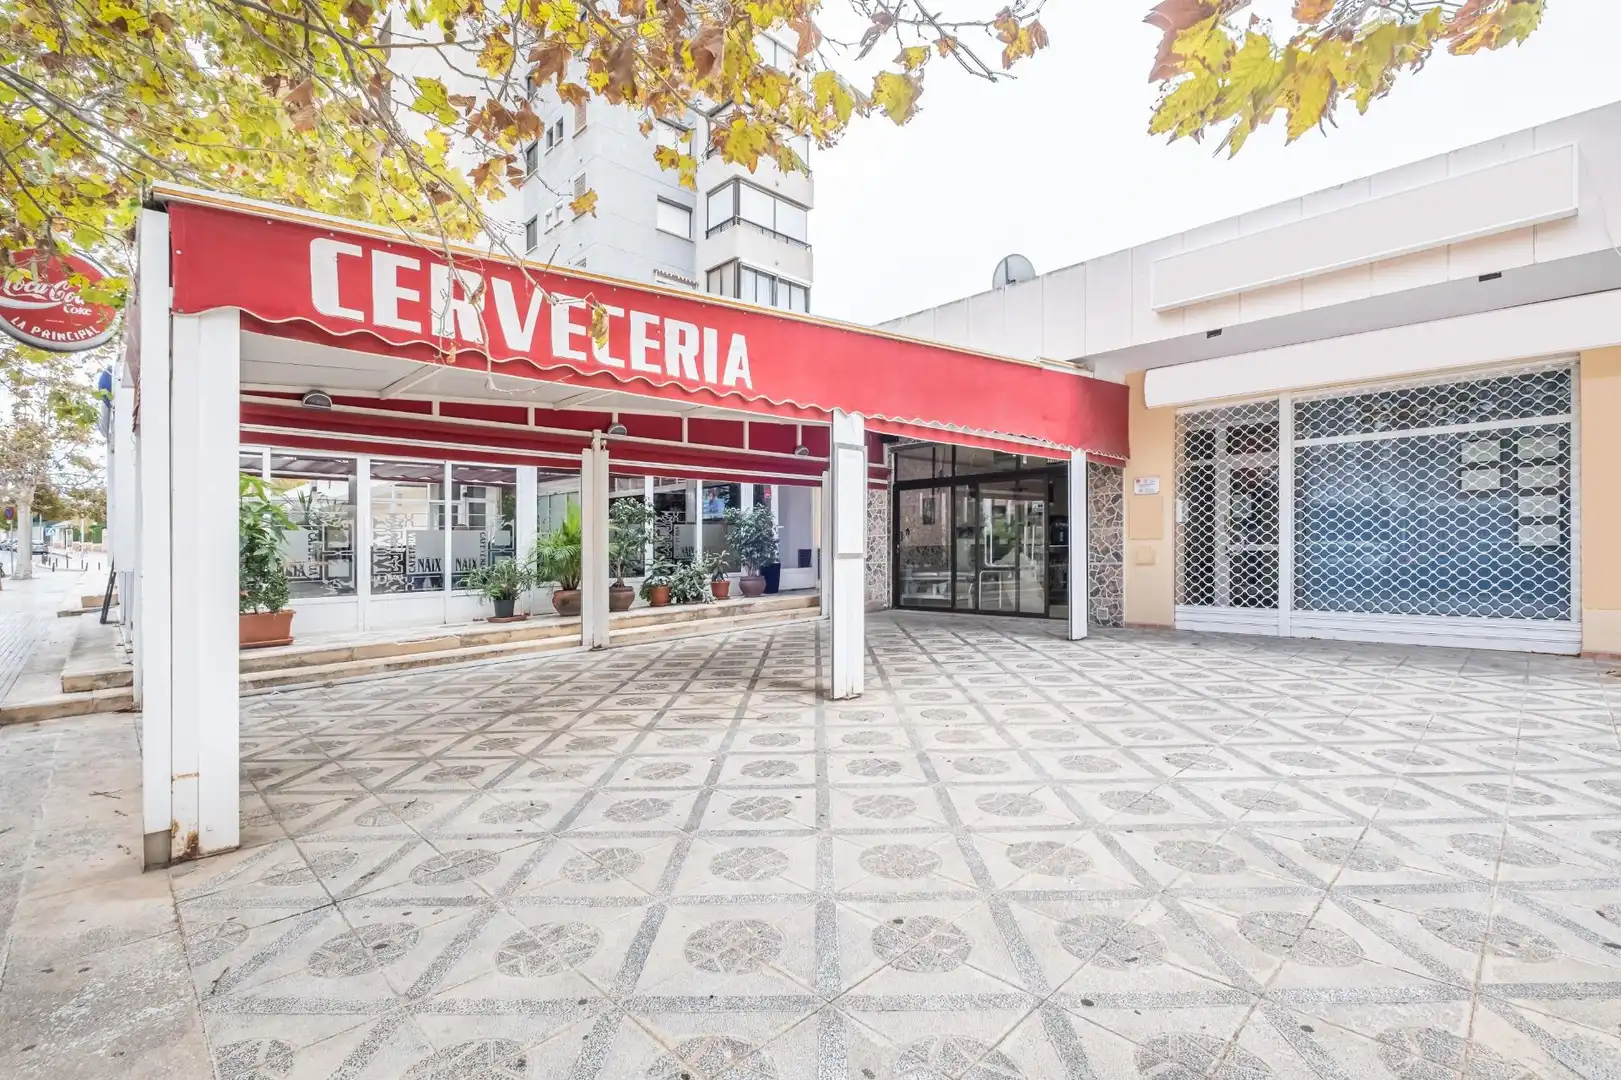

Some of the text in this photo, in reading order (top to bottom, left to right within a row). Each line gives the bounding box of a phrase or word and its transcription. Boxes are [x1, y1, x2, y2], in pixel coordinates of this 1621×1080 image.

[10, 316, 101, 341] LA PRINCIPAL
[310, 237, 754, 390] CERVECERIA
